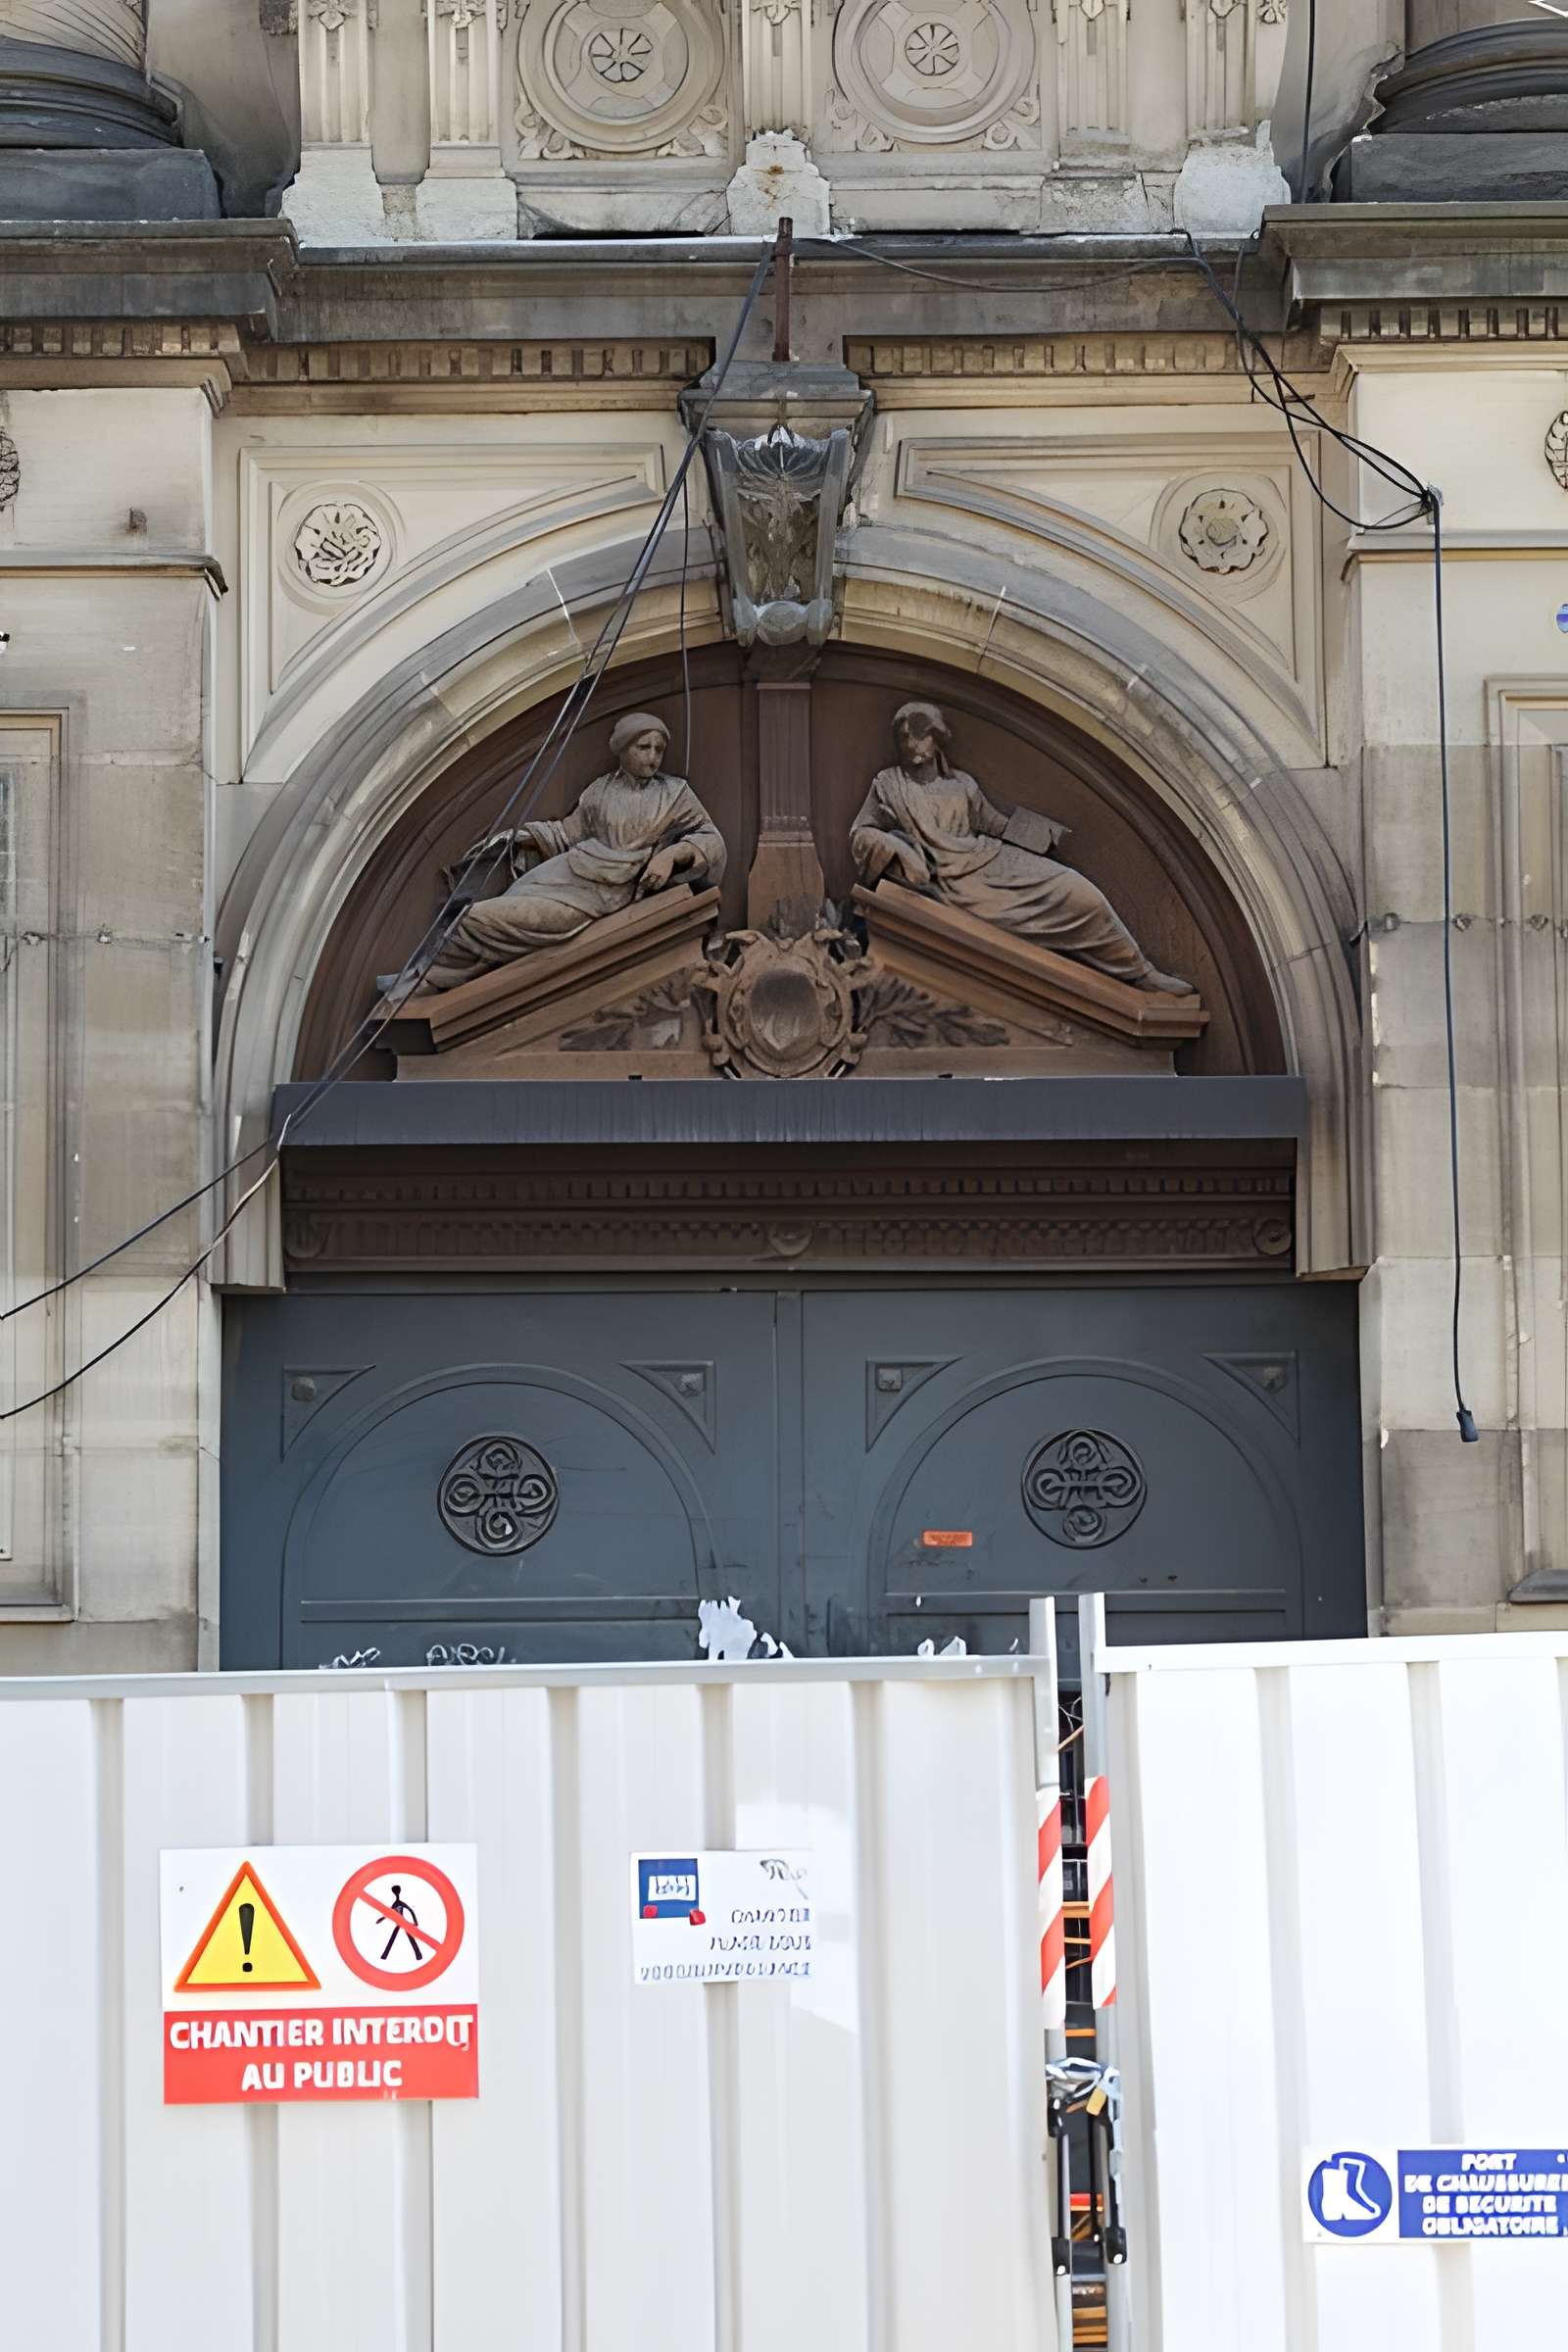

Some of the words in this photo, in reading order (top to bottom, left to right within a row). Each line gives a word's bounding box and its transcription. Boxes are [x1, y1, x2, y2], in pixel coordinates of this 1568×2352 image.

[170, 2019, 323, 2049] CHANTIER
[333, 2014, 473, 2049] INTERDIT
[241, 2062, 284, 2091] AU
[294, 2060, 403, 2089] PUBLIC
